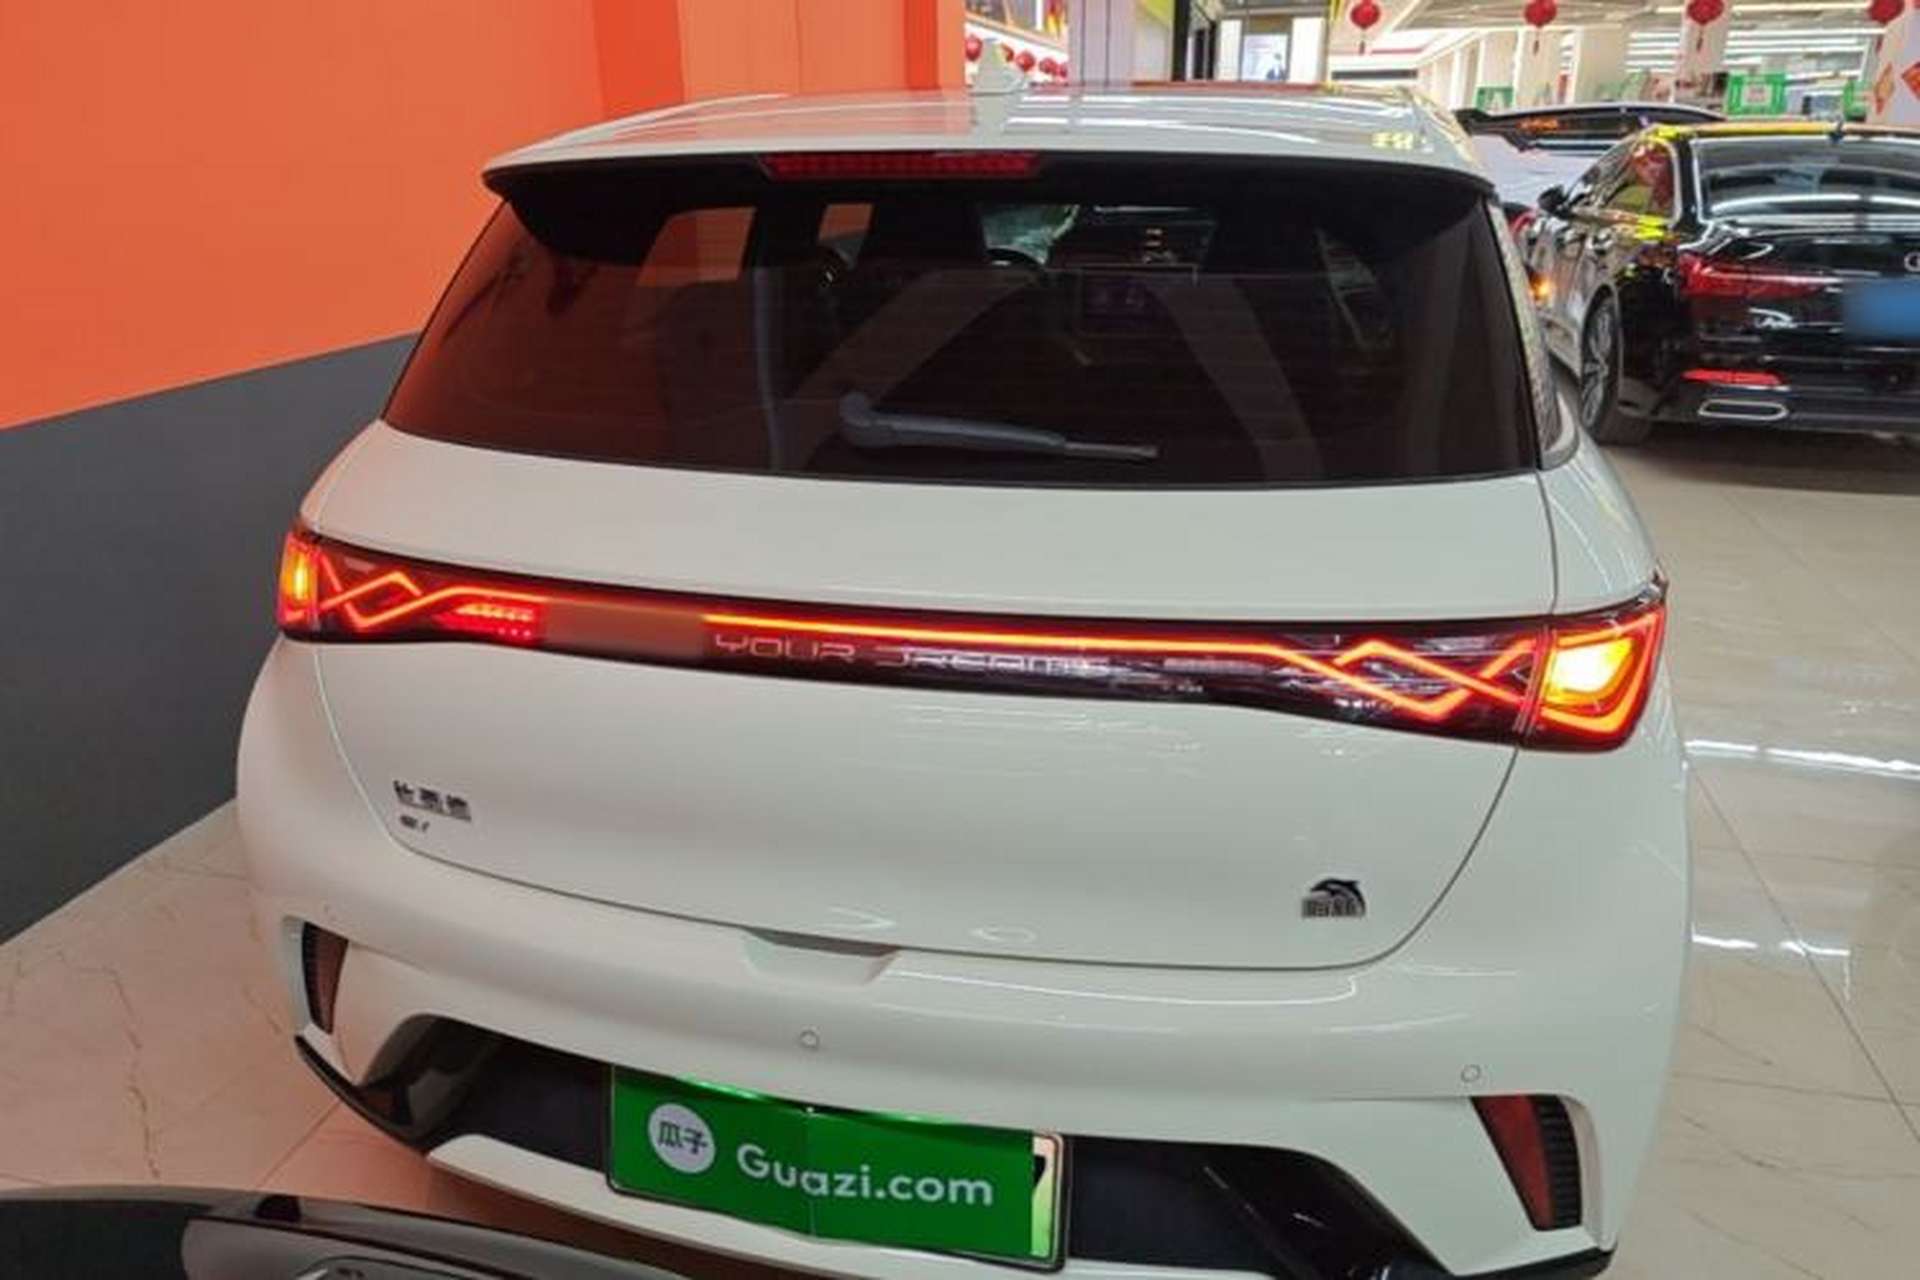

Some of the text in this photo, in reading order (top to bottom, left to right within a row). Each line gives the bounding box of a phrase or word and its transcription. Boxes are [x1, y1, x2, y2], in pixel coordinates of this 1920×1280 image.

[716, 633, 856, 664] YOUR
[658, 1120, 708, 1155] 瓜子
[737, 1143, 993, 1205] Guazi.com
